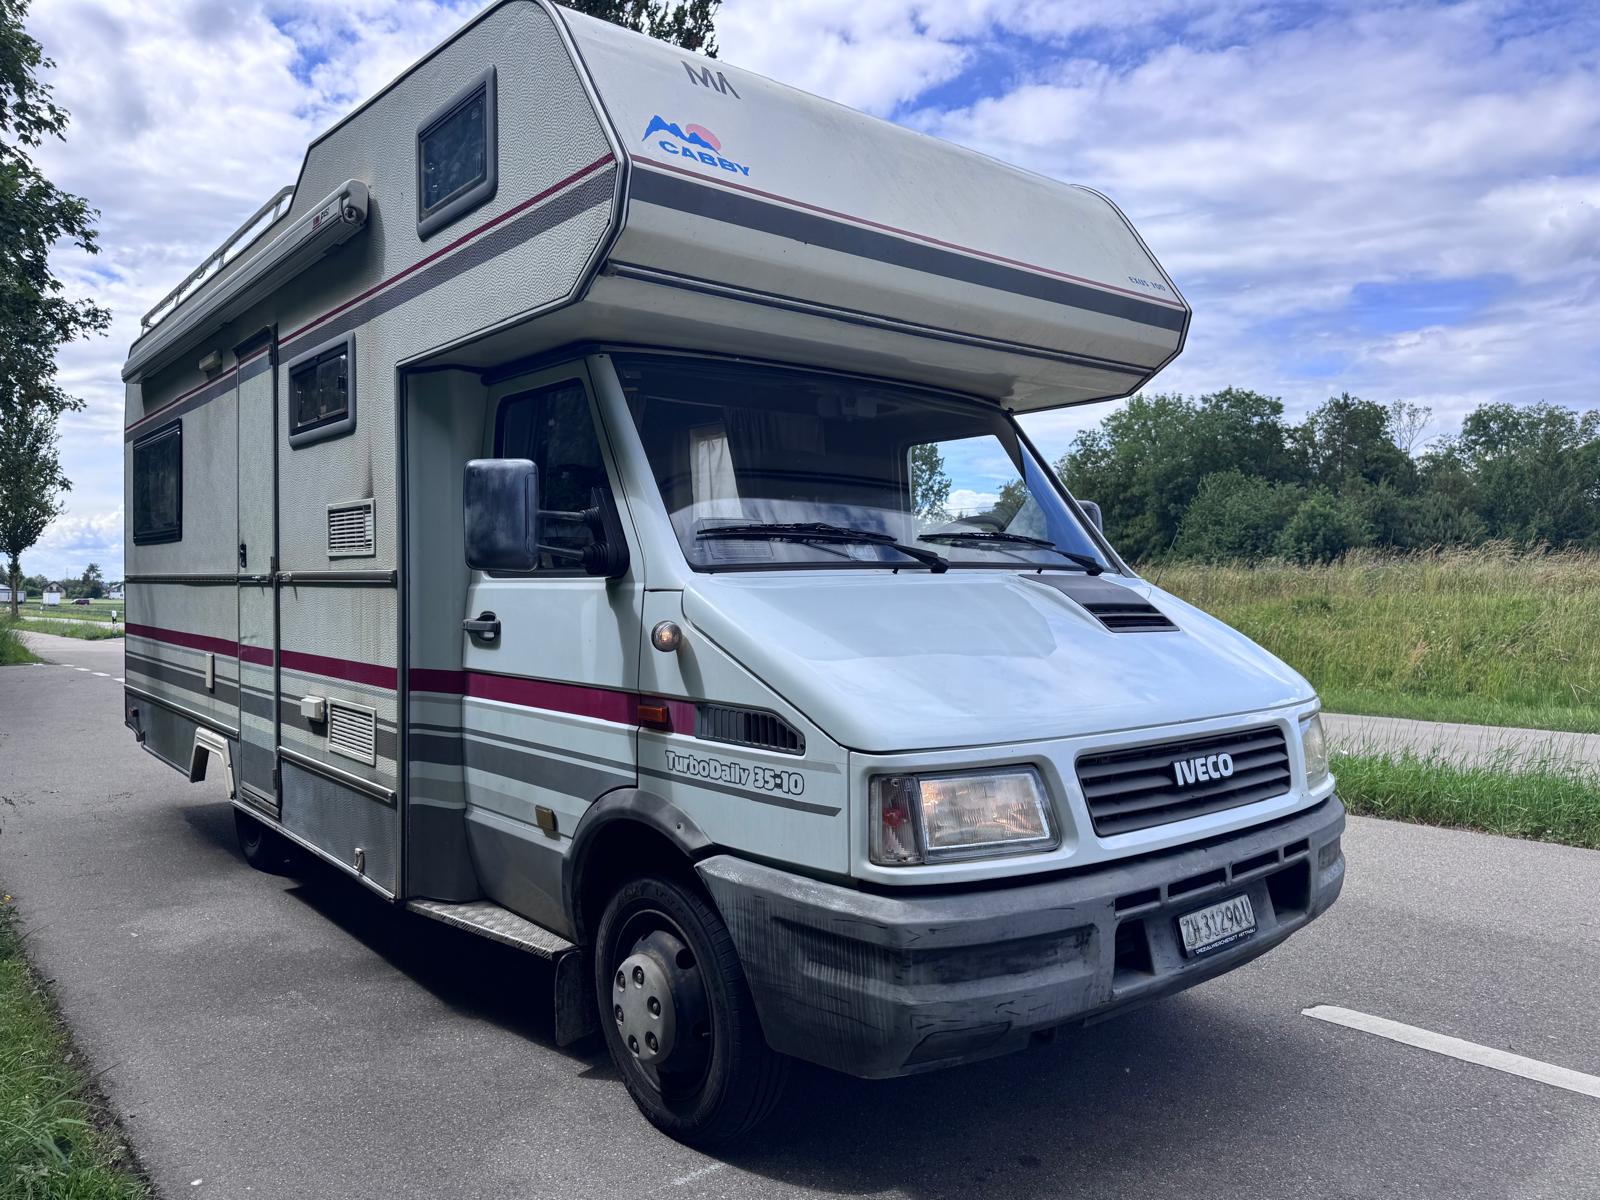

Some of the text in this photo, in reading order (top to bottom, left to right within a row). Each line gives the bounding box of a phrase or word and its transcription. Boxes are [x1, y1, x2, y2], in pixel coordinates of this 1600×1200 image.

[658, 140, 750, 177] CABBY
[665, 750, 805, 796] TurboDaily 35-10
[1174, 753, 1234, 786] IVECO
